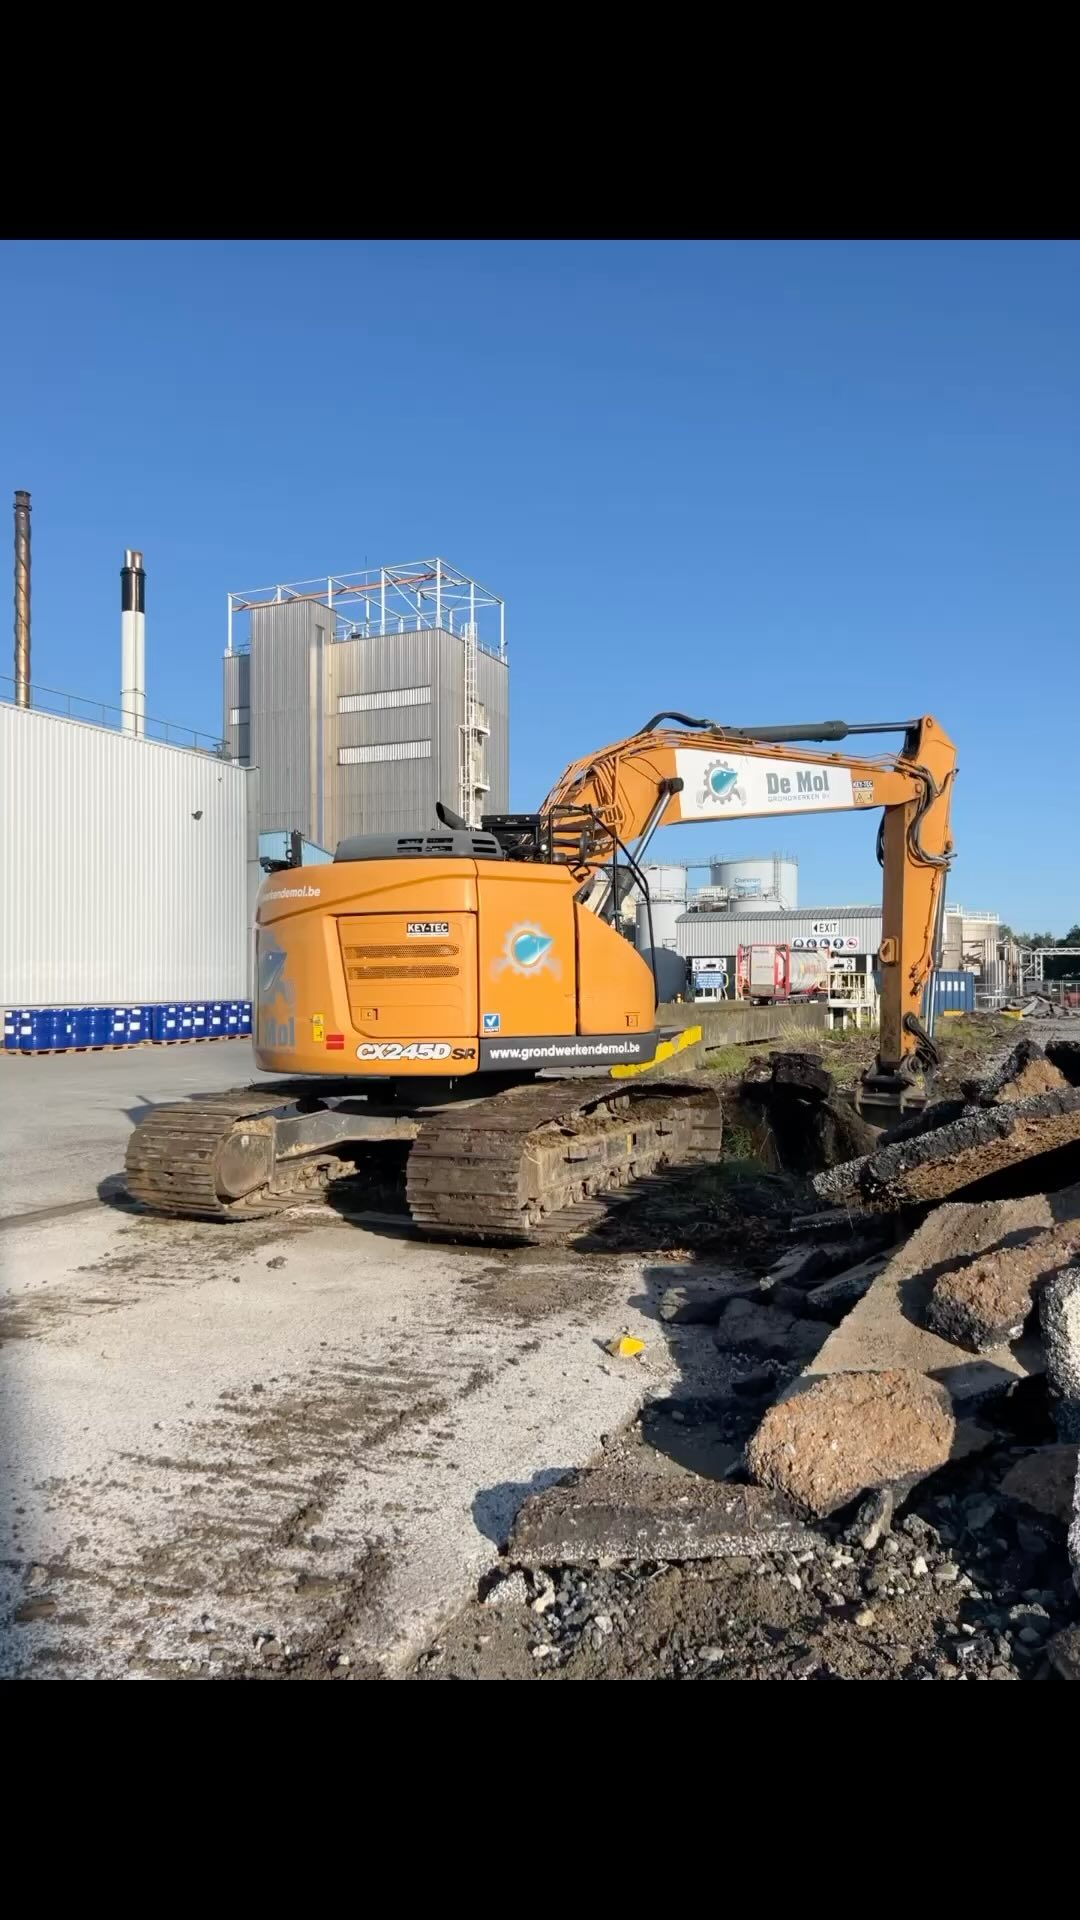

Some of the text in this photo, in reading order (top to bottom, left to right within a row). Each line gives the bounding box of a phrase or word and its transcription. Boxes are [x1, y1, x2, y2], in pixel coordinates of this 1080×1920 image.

[766, 770, 829, 795] De Mol
[407, 923, 448, 932] KEY-TEC
[819, 922, 838, 933] EXIT
[356, 1043, 476, 1060] CX245D SR
[489, 1041, 640, 1061] www.grondwerkendemol.be
